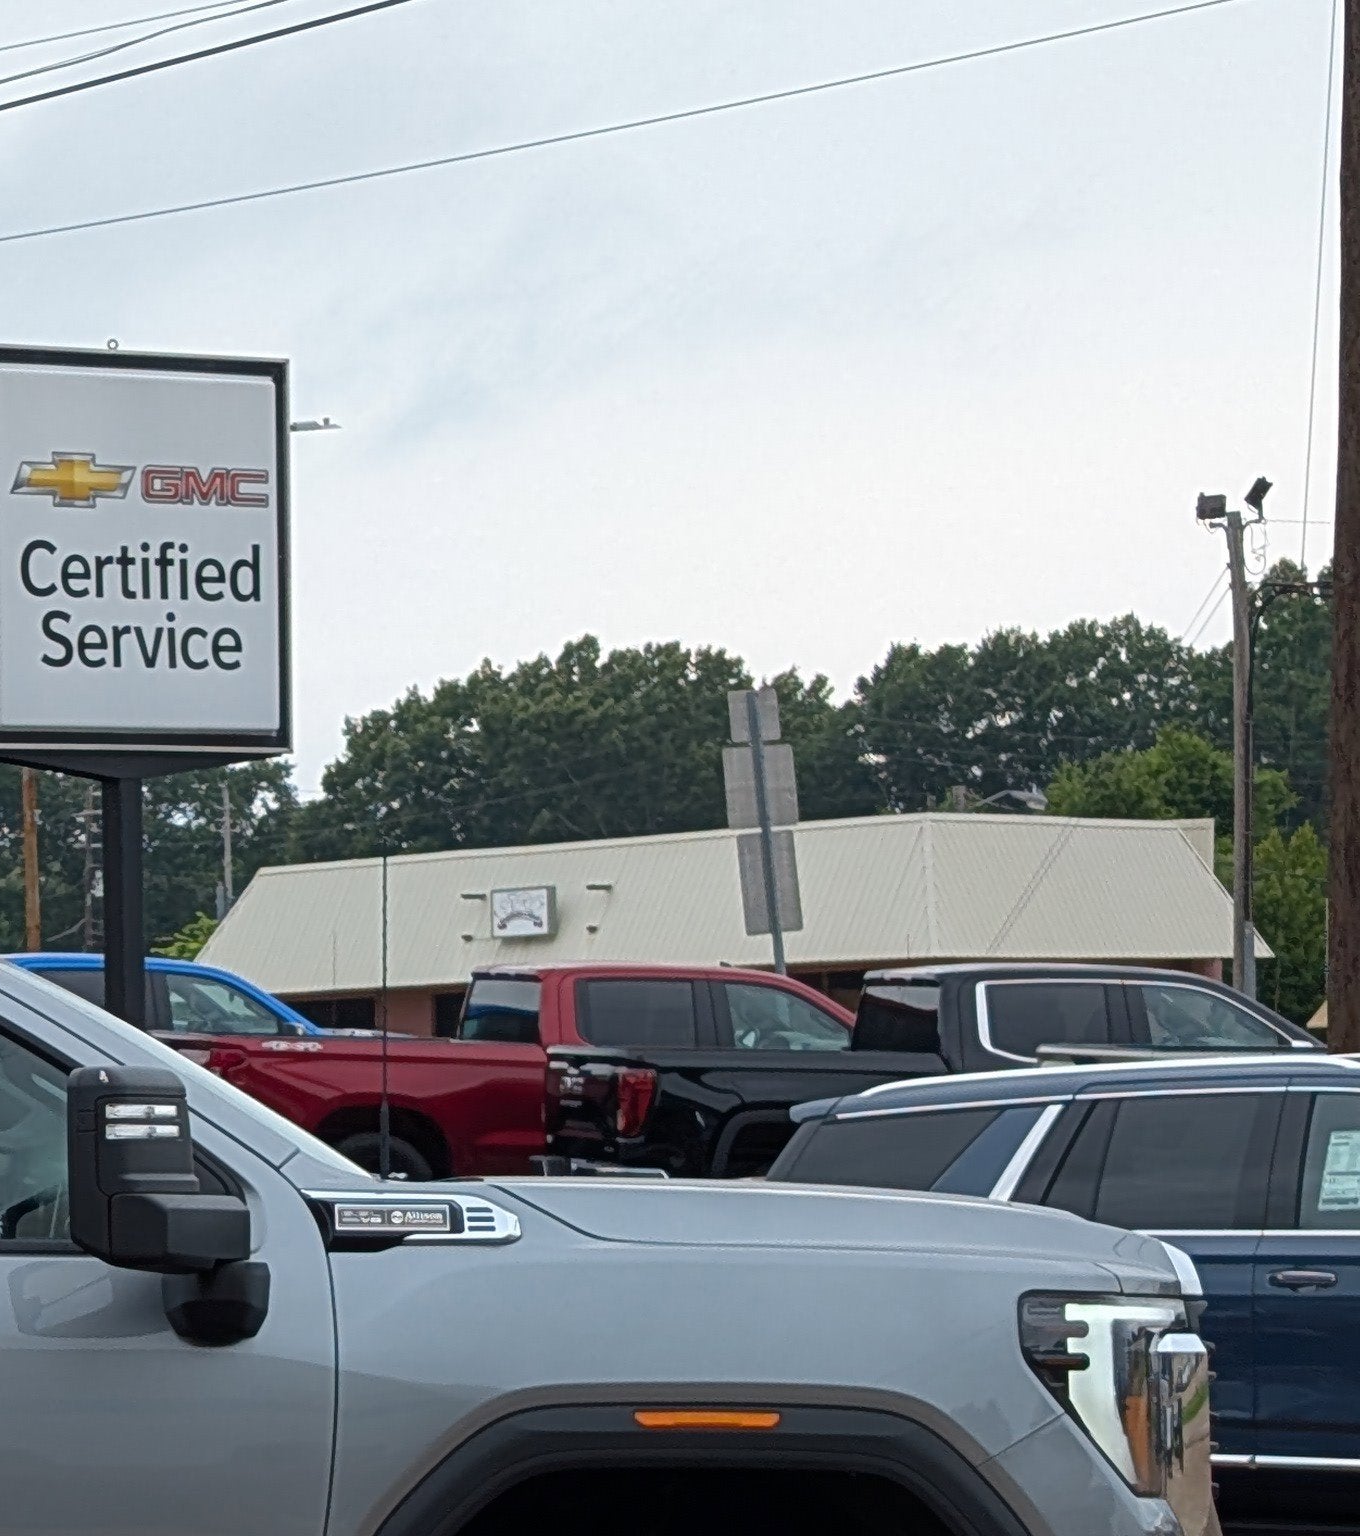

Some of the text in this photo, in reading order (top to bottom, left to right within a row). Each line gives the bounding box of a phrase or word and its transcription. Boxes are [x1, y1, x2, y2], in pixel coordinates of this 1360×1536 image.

[141, 464, 269, 508] GMC
[20, 539, 261, 602] Certified
[41, 609, 243, 670] Service
